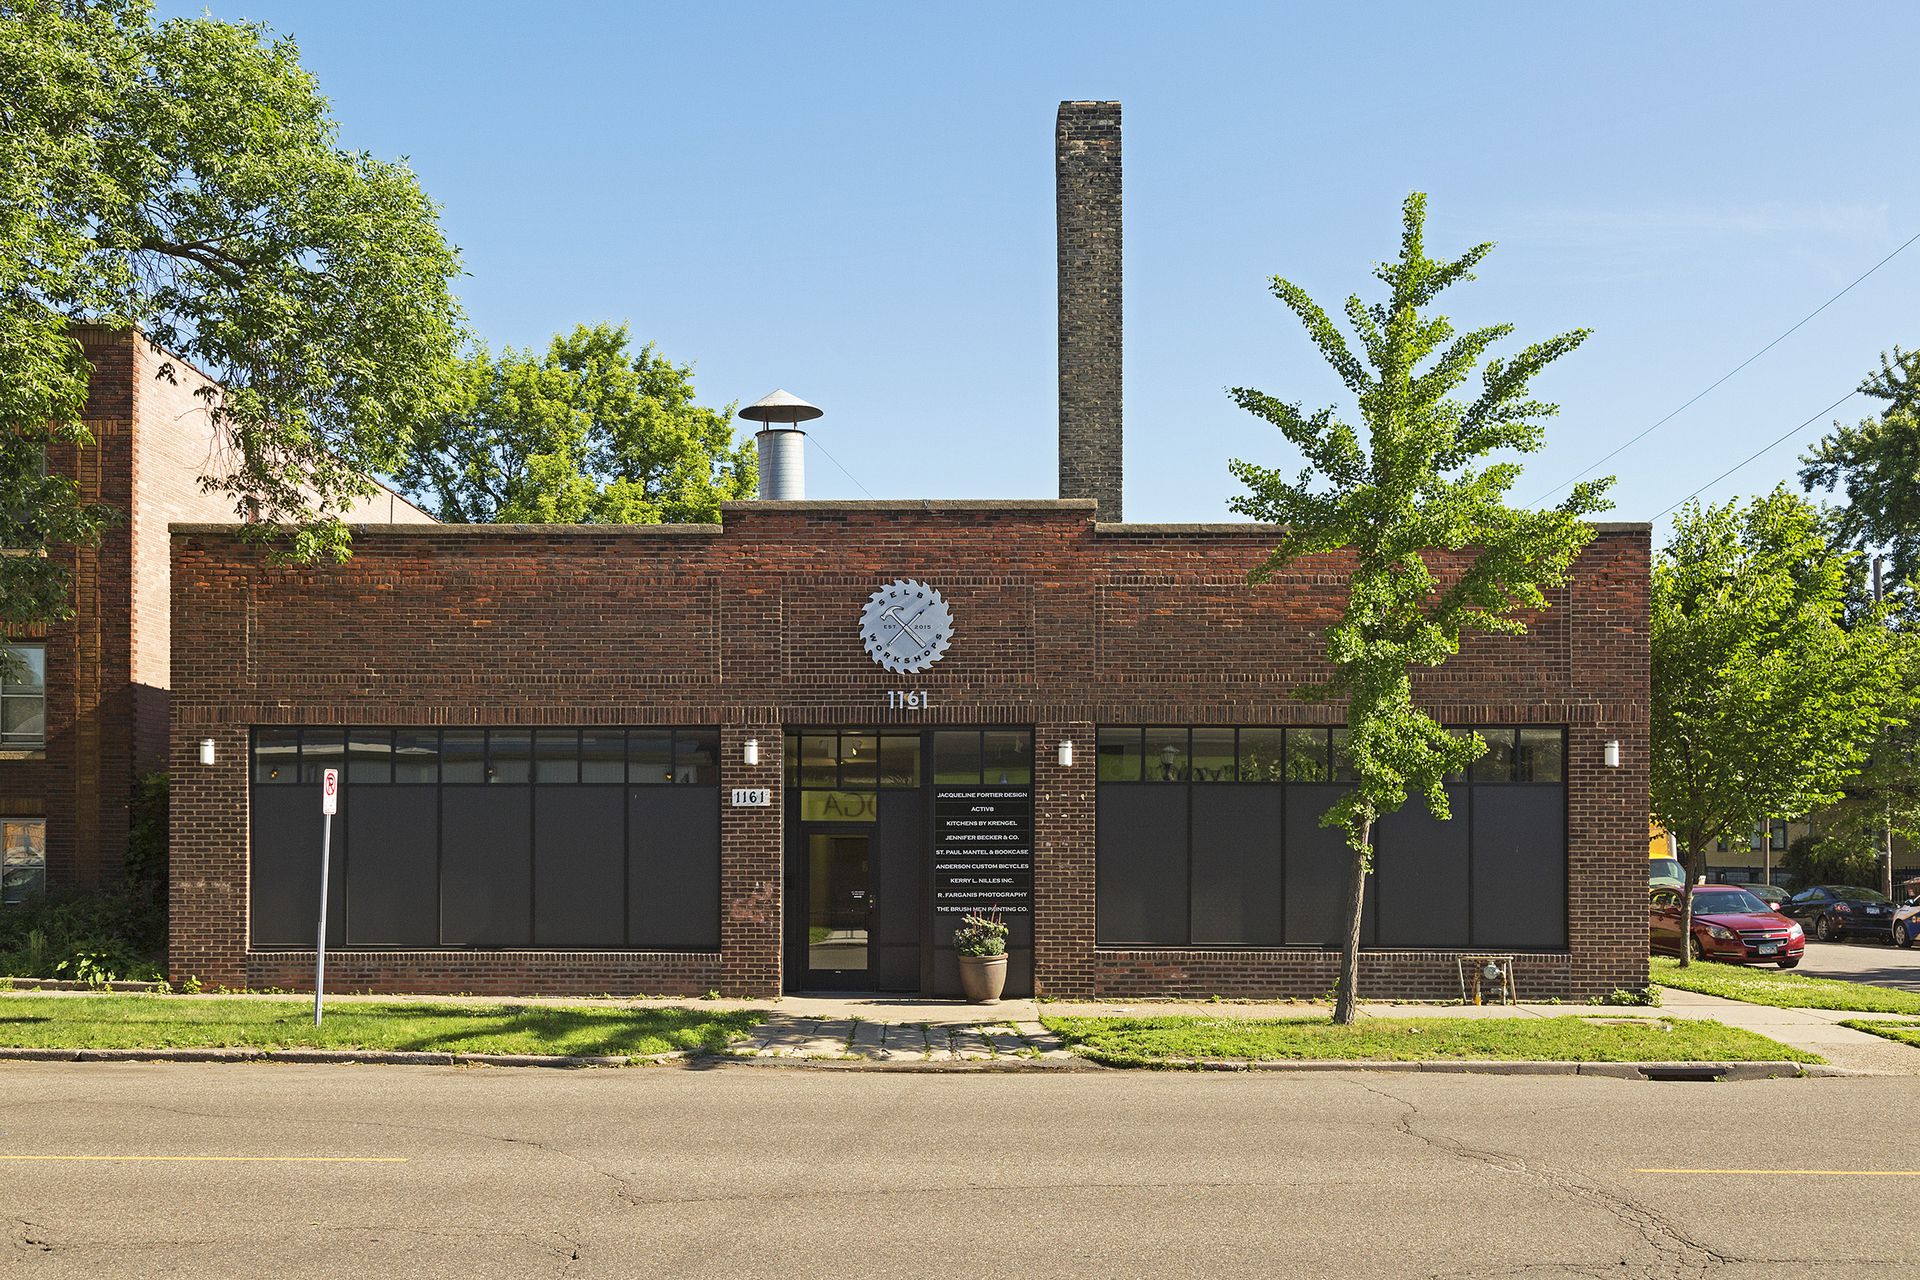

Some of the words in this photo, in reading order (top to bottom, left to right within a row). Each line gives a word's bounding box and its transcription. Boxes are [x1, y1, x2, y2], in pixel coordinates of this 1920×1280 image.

[878, 589, 935, 607] SELBY
[869, 632, 942, 664] WORKSHOPS
[888, 690, 928, 709] 1161
[736, 791, 764, 803] 1161
